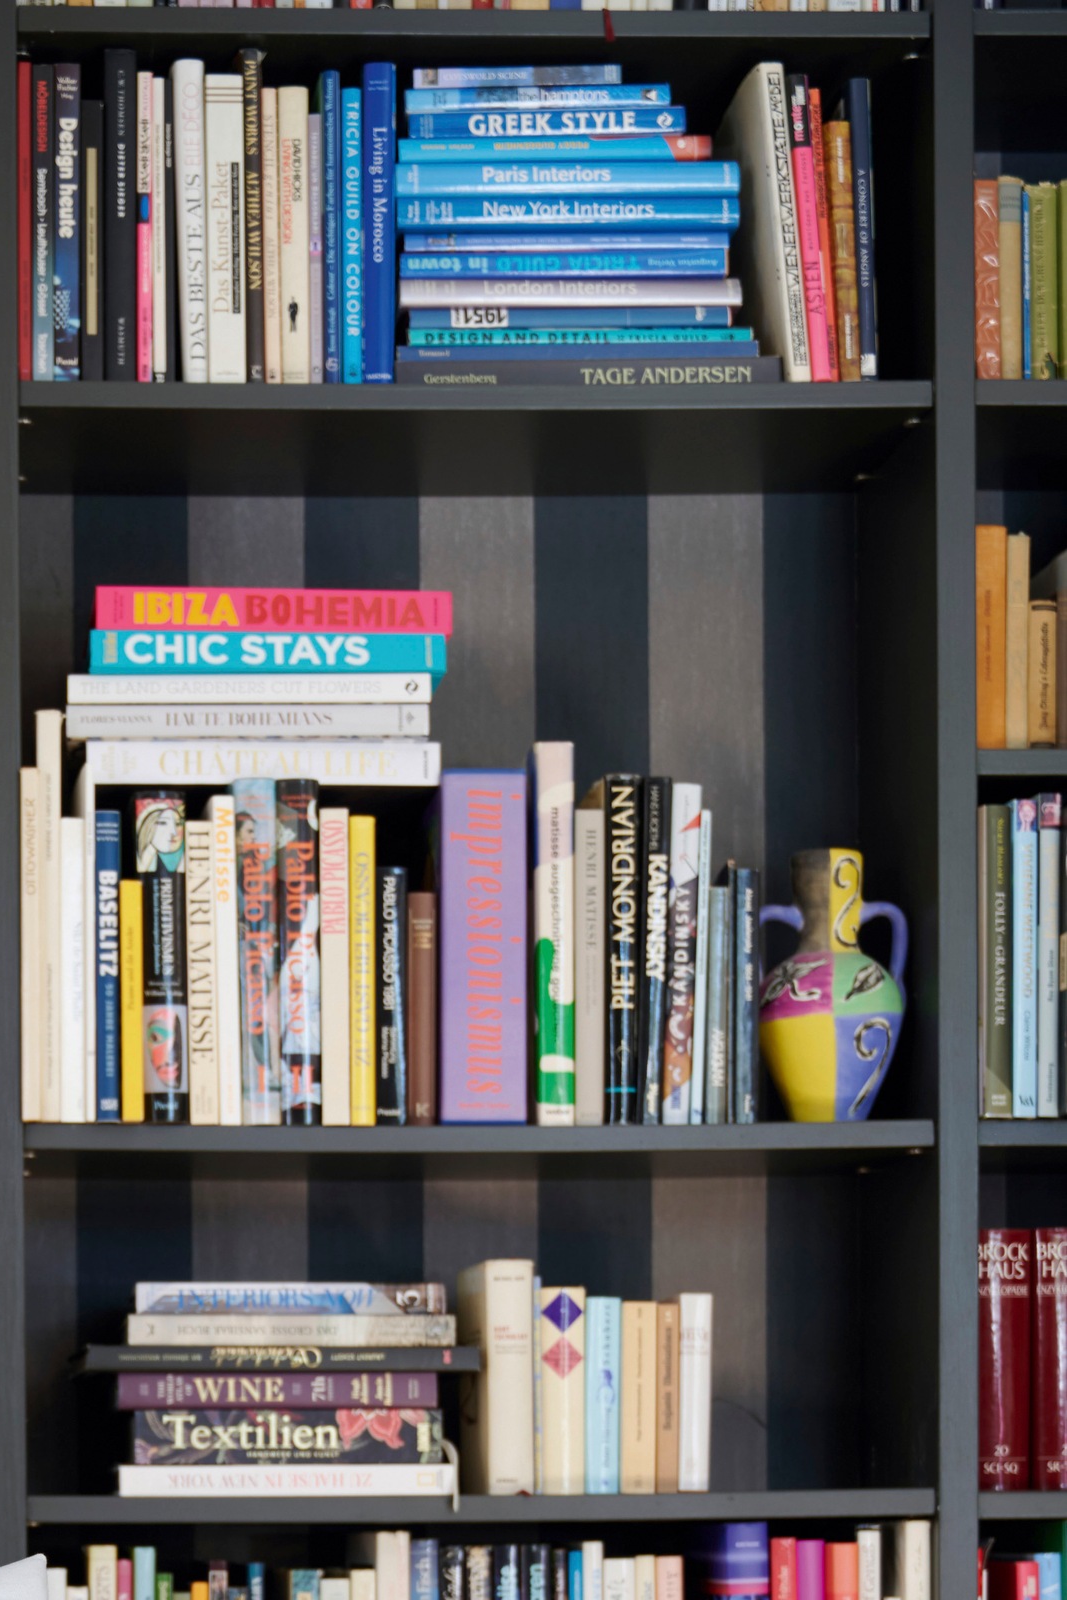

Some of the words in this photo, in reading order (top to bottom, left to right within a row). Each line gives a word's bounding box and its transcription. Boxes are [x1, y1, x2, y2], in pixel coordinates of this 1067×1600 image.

[244, 60, 257, 102] PAINT
[540, 88, 608, 103] hamptons
[36, 80, 48, 152] MÖBELDESIGN
[246, 104, 258, 155] WORKS
[346, 102, 359, 158] TRICIA
[468, 114, 551, 136] GREEK
[561, 112, 636, 132] STYLE
[56, 117, 77, 179] Design
[282, 139, 291, 171] LIVING
[292, 139, 301, 168] DAVID
[369, 127, 388, 174] Living
[36, 168, 47, 216] Sembach
[186, 174, 201, 219] AUS
[292, 169, 302, 202] HICKS
[346, 166, 359, 219] GUILD
[373, 179, 387, 193] in
[482, 166, 528, 182] Paris
[533, 166, 611, 182] Interiors
[58, 184, 77, 238] heute
[212, 162, 230, 272] Kunst-Paket
[247, 171, 260, 228] ALTHEA
[483, 201, 525, 217] New
[529, 201, 572, 217] York
[574, 201, 655, 217] Interiors
[858, 179, 868, 228] CONCERT
[282, 203, 292, 244] DESIGN
[346, 227, 359, 256] ON
[373, 198, 387, 263] Morocco
[188, 224, 204, 302] BESTE
[248, 231, 261, 290] WILSON
[407, 257, 461, 272] town
[469, 257, 488, 273] in
[496, 256, 560, 272] GUILD
[568, 256, 640, 272] TRICIA
[783, 224, 800, 285] WIENER
[213, 279, 230, 313] Das
[347, 273, 360, 337] COLOUR
[484, 281, 554, 296] London
[559, 281, 638, 296] Interiors
[806, 261, 822, 315] ASIEN
[189, 313, 206, 360] DAS
[425, 332, 493, 345] DESIGN
[502, 331, 540, 344] AND
[548, 331, 610, 344] DETAIL
[463, 308, 506, 325] 1951
[424, 373, 497, 385] Gerstenberg
[580, 367, 635, 385] TAGE
[641, 366, 752, 385] ANDERSEN
[134, 592, 240, 626] IBIZA
[245, 595, 425, 628] BOHEMIA
[124, 634, 229, 665] CHIC
[241, 635, 370, 666] STAYS
[81, 681, 112, 695] THE
[115, 681, 161, 695] LAND
[167, 681, 267, 695] GARDENERS
[272, 681, 304, 694] CUT
[308, 680, 381, 694] FLOWERS
[165, 712, 221, 726] HAUTE
[228, 712, 333, 726] BOHEMIANS
[159, 745, 311, 776] CHÂTEAU
[324, 751, 397, 776] LIFE
[215, 807, 234, 903] Matisse
[322, 820, 346, 881] PICASSO
[550, 807, 561, 859] matisse
[585, 829, 597, 878] HENRI
[189, 831, 211, 928] HENRI
[243, 842, 273, 922] Pablo
[285, 840, 315, 921] Pablo
[611, 785, 634, 942] MONDRIAN
[322, 887, 346, 934] PABLO
[356, 852, 370, 934] PICASSO
[383, 877, 395, 921] PABLO
[995, 892, 1006, 933] FOLLY
[99, 871, 117, 976] BASELITZ
[549, 863, 562, 972] ausgeschnittene
[585, 886, 597, 950] MATISSE
[646, 855, 667, 981] KANDINSKY
[383, 924, 395, 983] PICASSO
[450, 789, 522, 1094] impressionismus
[673, 886, 689, 1006] KANDINSKY
[190, 942, 214, 1064] MATISSE
[246, 930, 277, 1035] Picasso
[287, 931, 315, 1035] Picasso
[612, 953, 634, 1009] PIET
[995, 945, 1006, 1026] GRANDEUR
[977, 1241, 1028, 1262] BROCK
[978, 1262, 1025, 1280] HAUS
[194, 1377, 284, 1402] WINE
[312, 1376, 326, 1401] 7th
[163, 1414, 340, 1449] Textilien
[168, 1474, 212, 1487] YORK
[218, 1474, 258, 1487] NEW
[264, 1474, 283, 1486] IN
[287, 1474, 344, 1487] HAUSE
[349, 1474, 372, 1487] ZU
[416, 1558, 429, 1593] Fisch
